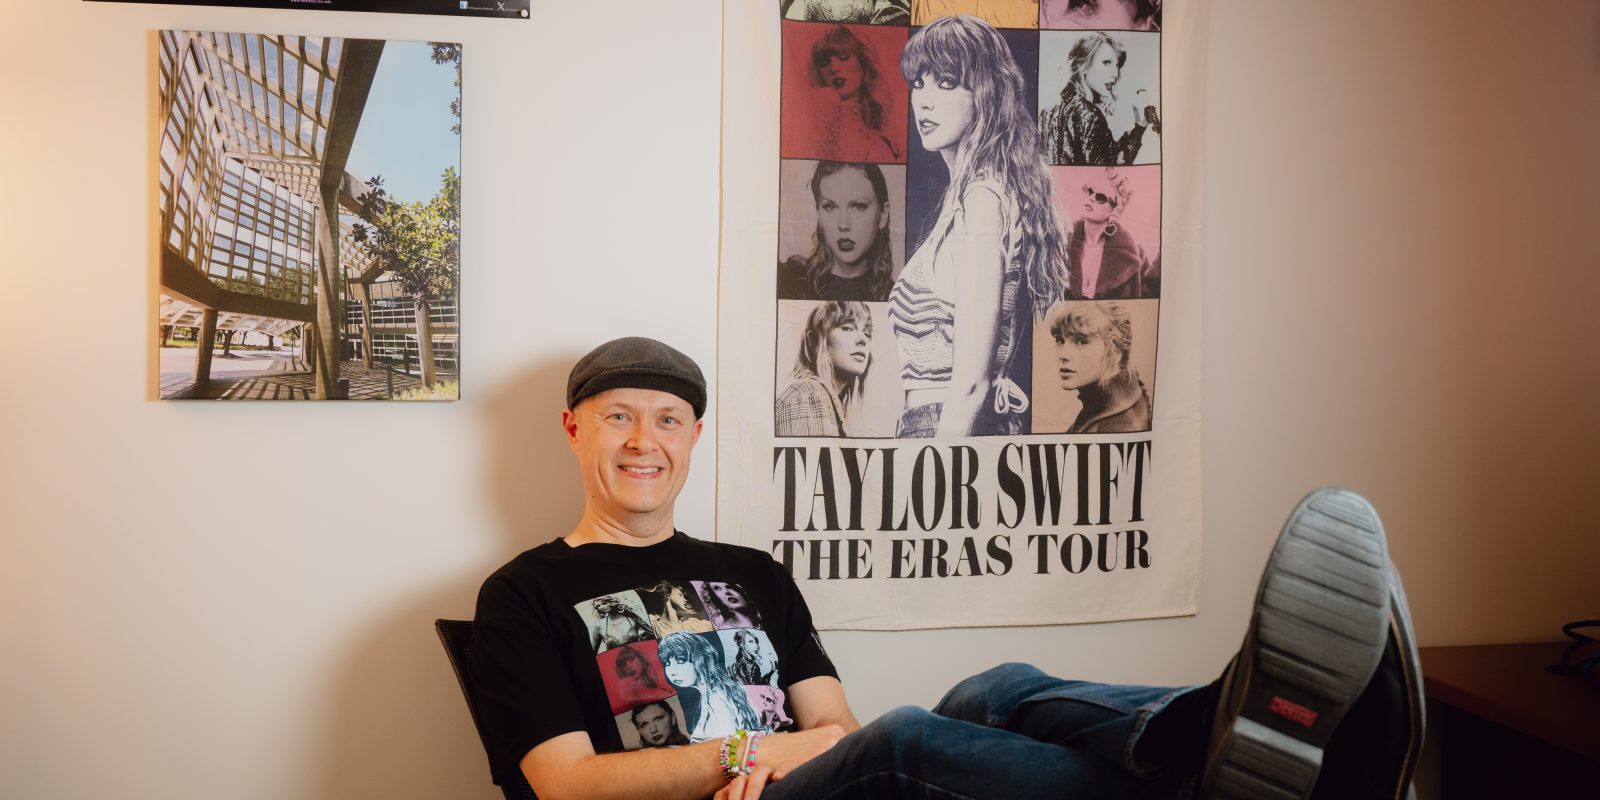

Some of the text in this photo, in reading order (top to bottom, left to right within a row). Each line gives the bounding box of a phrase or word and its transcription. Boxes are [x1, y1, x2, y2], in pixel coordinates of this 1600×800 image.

[773, 439, 1152, 532] TAYLOR SWIFT
[772, 529, 1152, 580] THE ERAS TOUR
